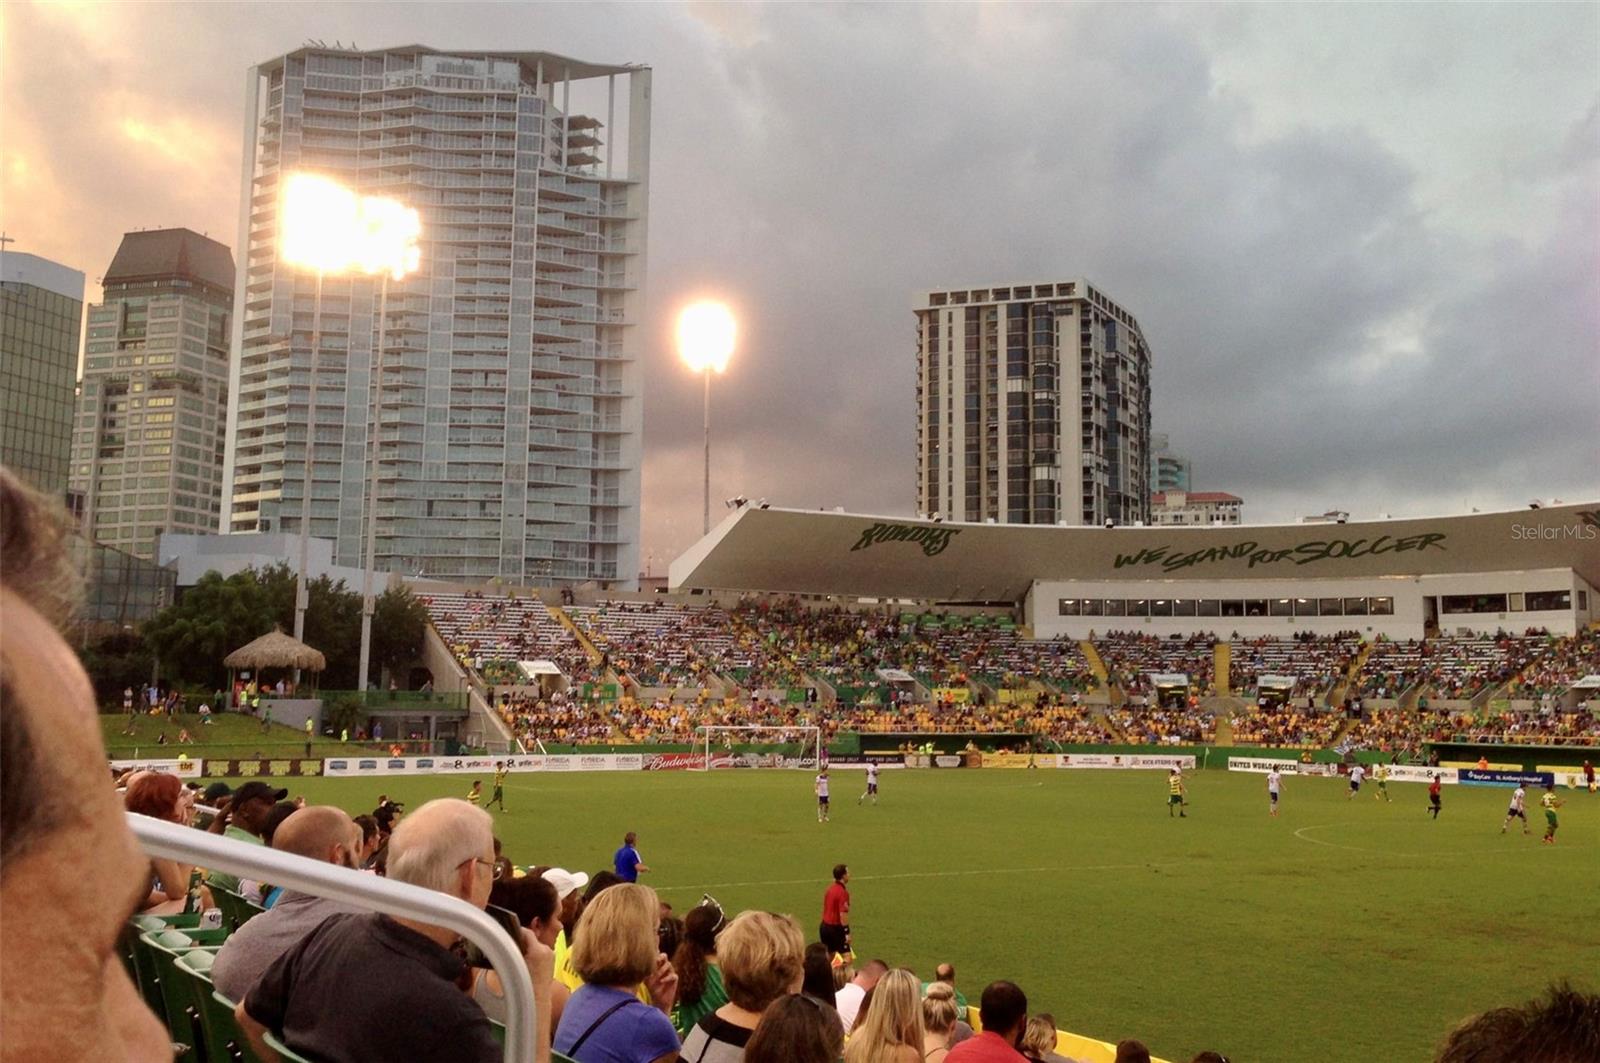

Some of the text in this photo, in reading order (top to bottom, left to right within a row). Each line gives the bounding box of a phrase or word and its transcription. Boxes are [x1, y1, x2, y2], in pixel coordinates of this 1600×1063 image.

[1113, 533, 1447, 573] WE STAND FOR SOCCER
[1229, 760, 1251, 769] UNITED
[1252, 762, 1272, 770] WORLD
[1274, 763, 1297, 771] OCCER
